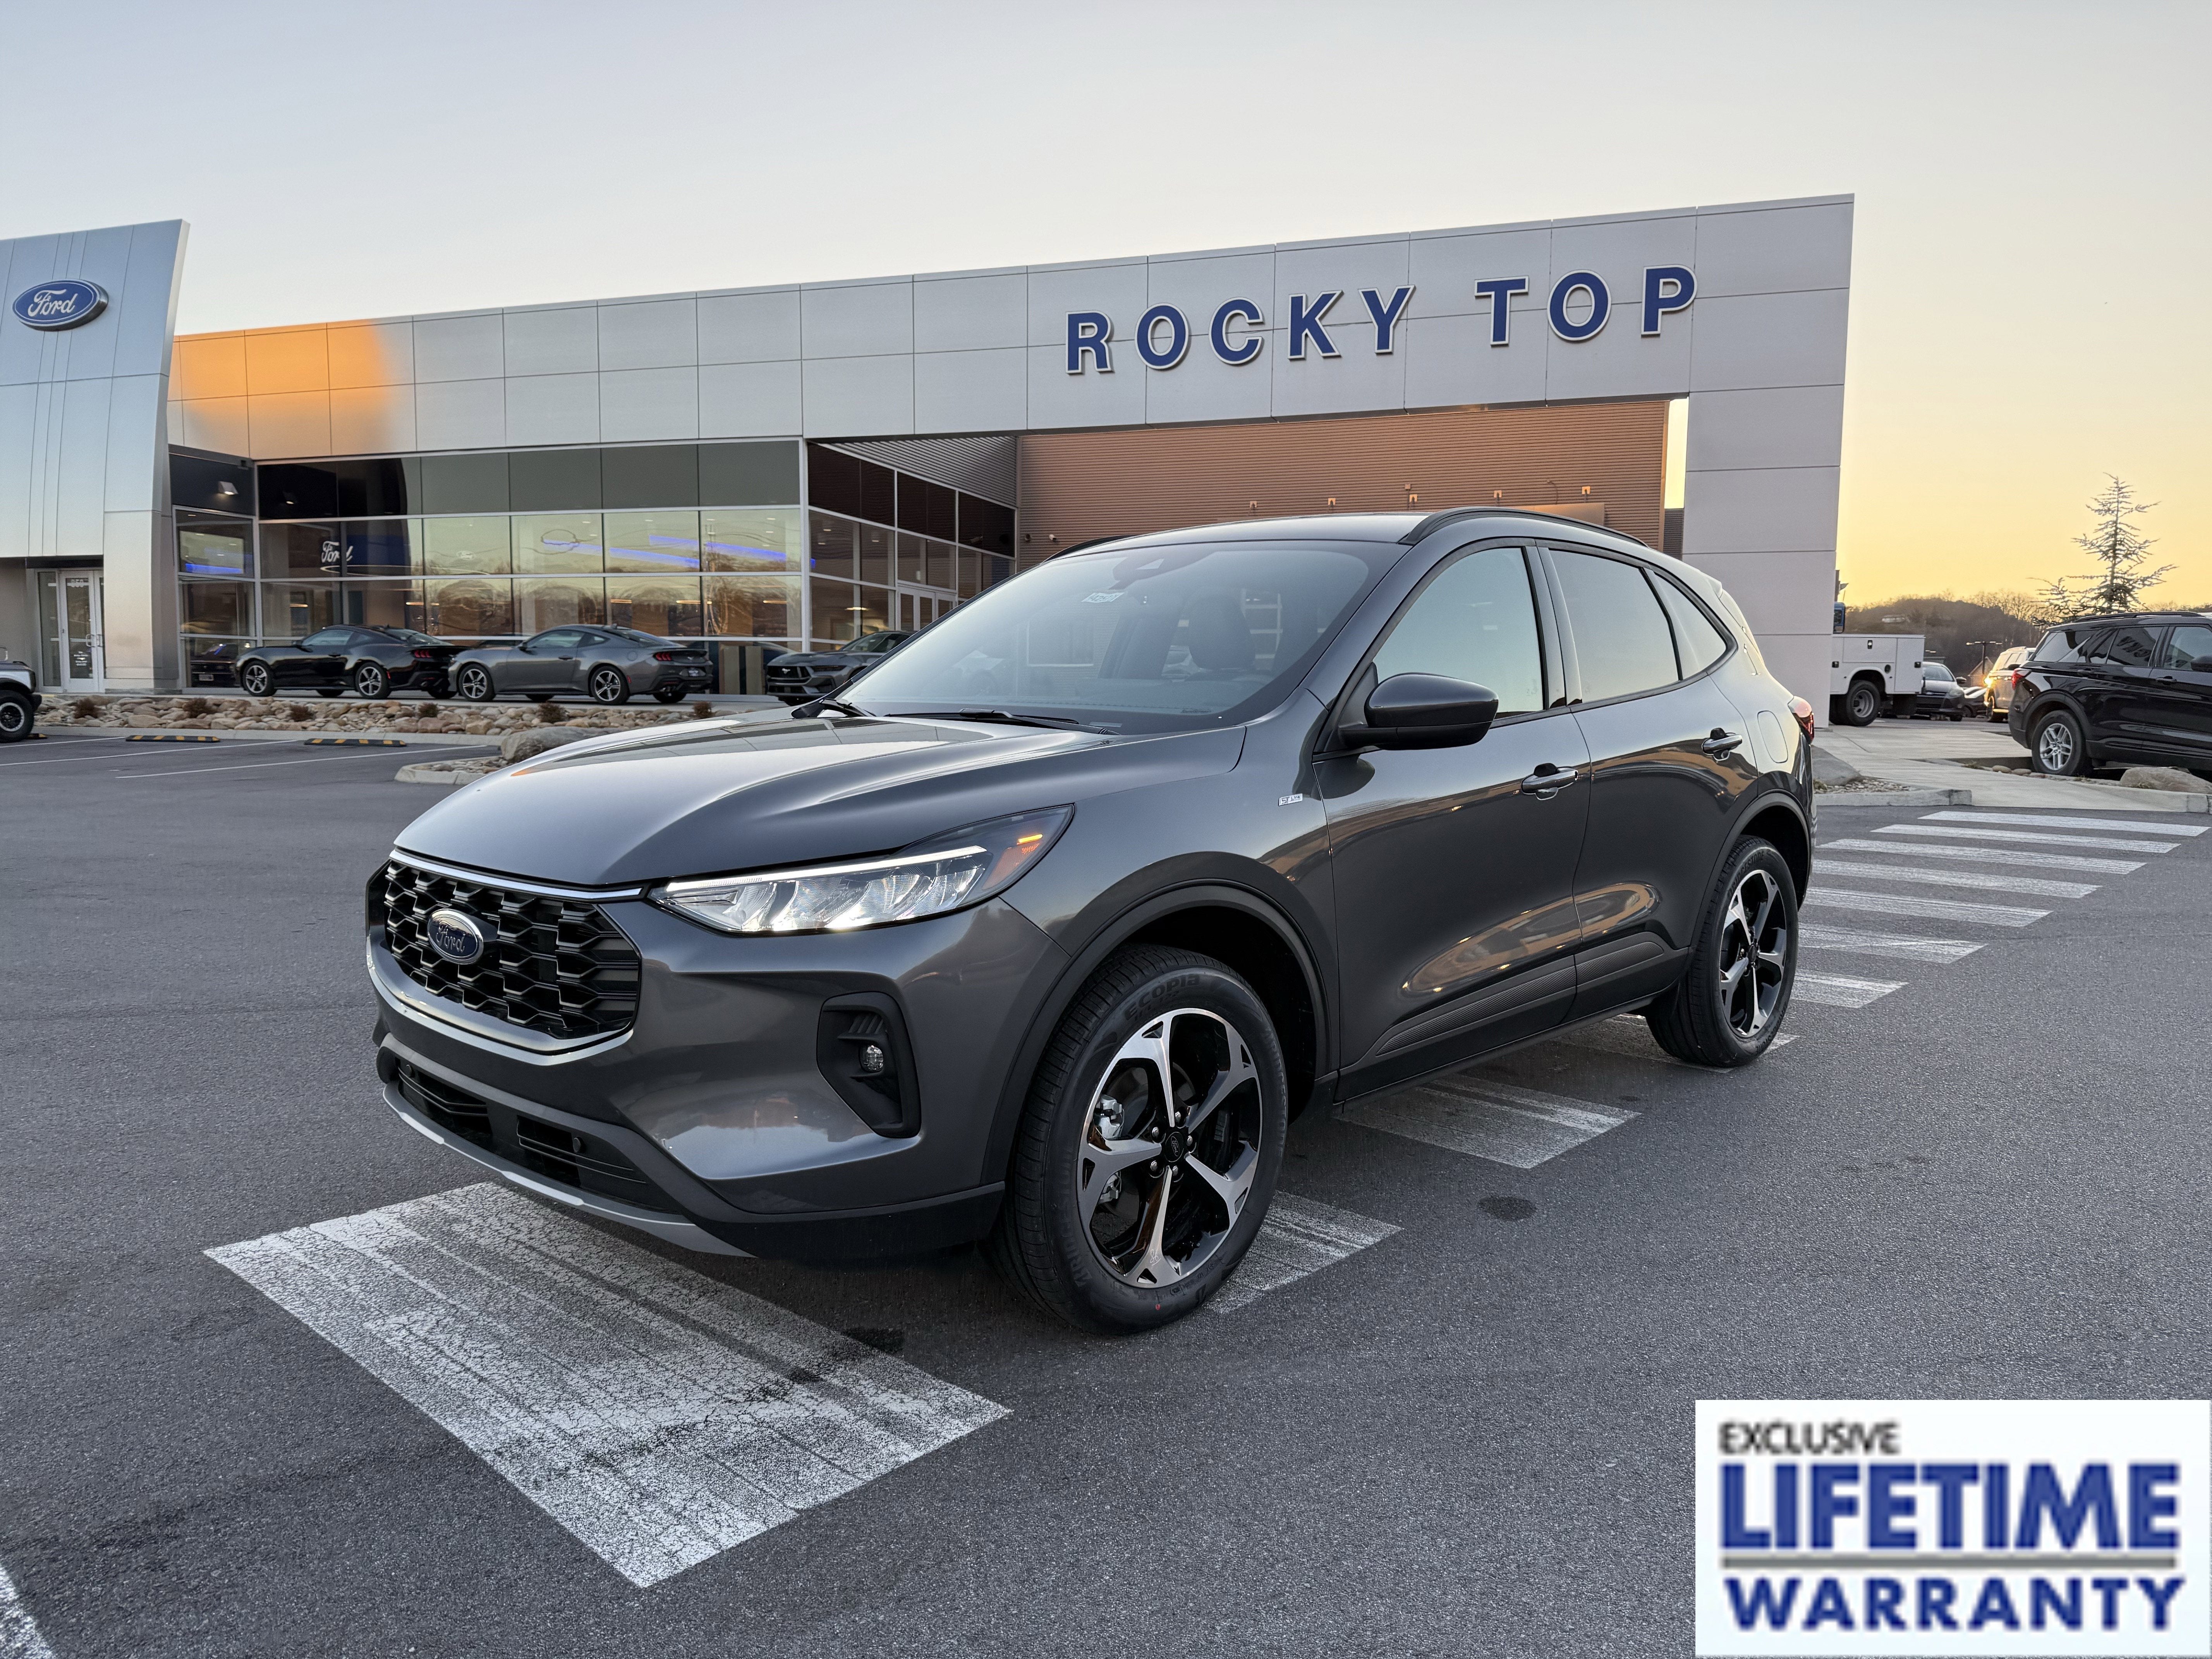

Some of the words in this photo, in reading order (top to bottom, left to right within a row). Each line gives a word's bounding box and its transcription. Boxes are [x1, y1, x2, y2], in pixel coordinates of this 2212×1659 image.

[28, 289, 78, 317] Ford
[1065, 285, 1415, 374] ROCKY
[1475, 264, 1697, 346] TOP
[436, 921, 465, 953] Ford
